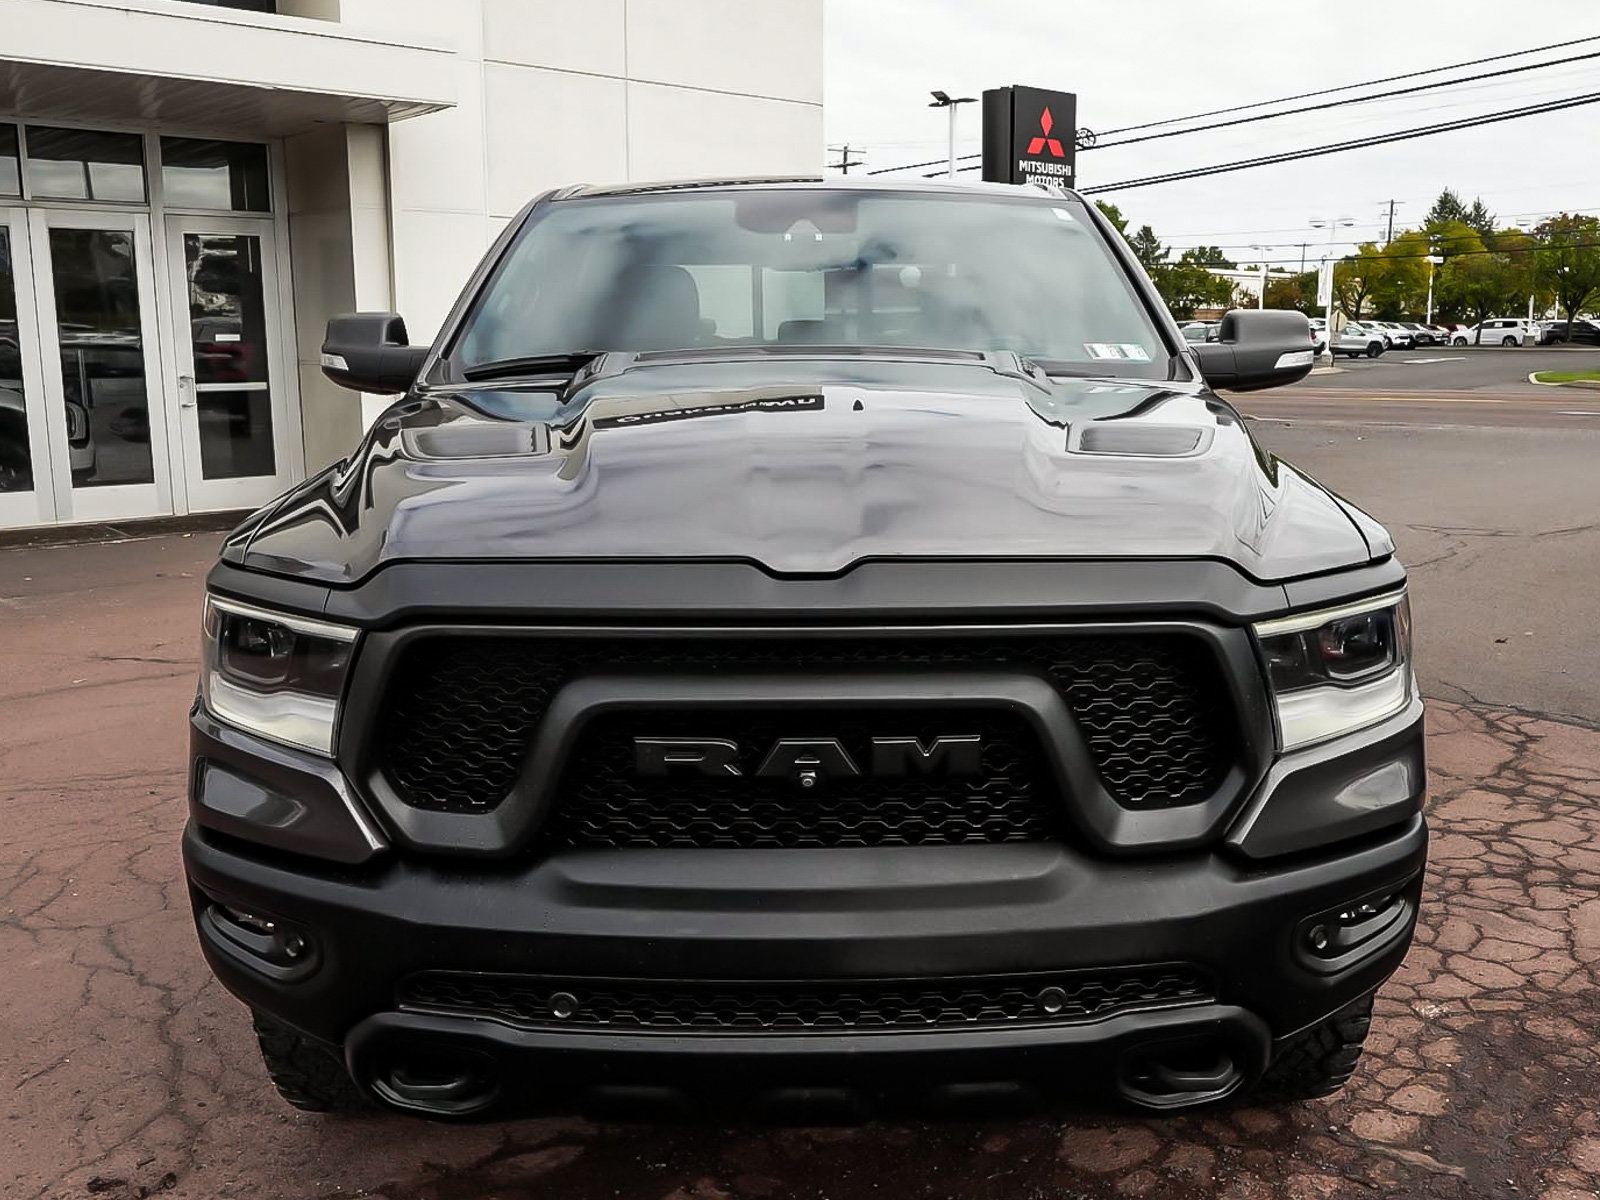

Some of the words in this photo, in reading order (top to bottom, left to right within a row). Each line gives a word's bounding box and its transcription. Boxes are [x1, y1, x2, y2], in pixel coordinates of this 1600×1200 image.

[1019, 160, 1071, 176] MITSUBISHI
[1026, 174, 1065, 188] MOTORS
[634, 735, 981, 776] RAM
